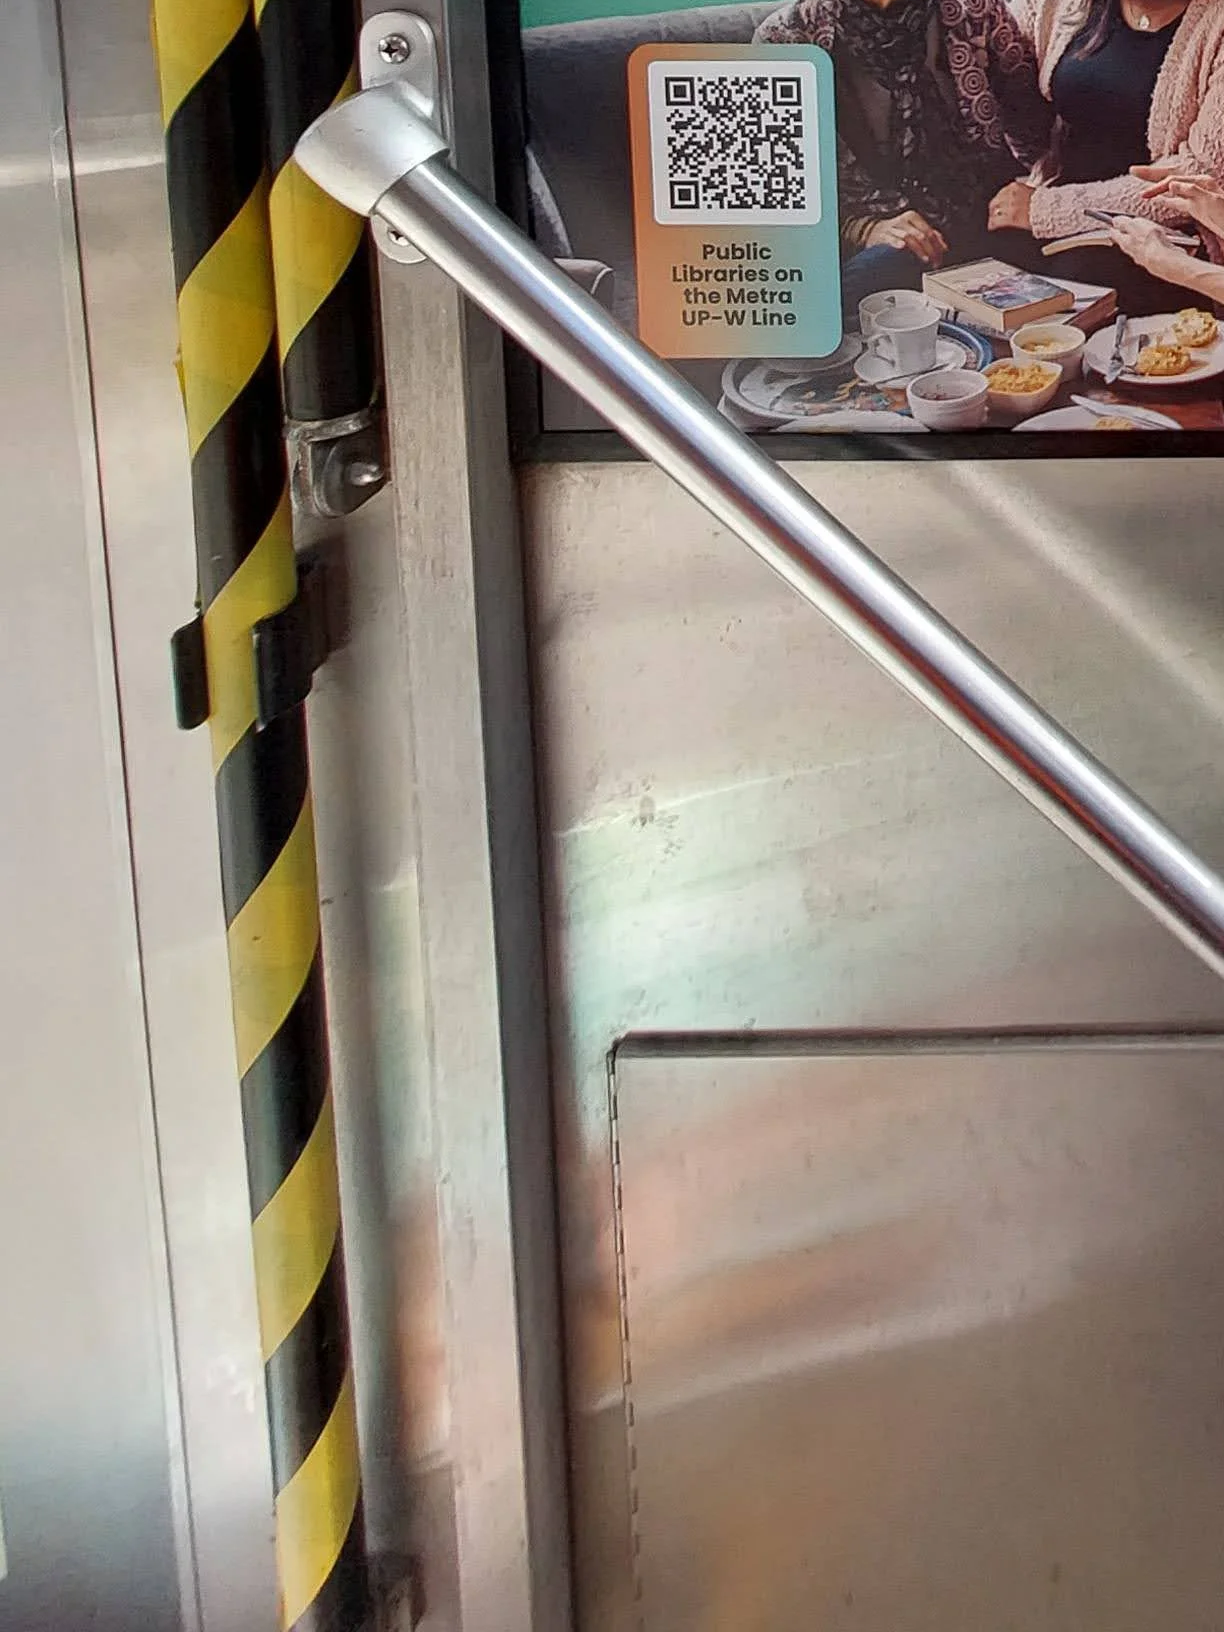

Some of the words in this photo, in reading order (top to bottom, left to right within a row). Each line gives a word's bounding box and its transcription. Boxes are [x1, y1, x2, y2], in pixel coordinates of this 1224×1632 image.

[702, 242, 772, 261] Public
[672, 264, 770, 283] Libraries
[774, 268, 804, 282] on
[684, 287, 721, 304] the
[726, 288, 793, 305] Metra
[682, 310, 746, 326] UP-W
[752, 308, 797, 326] Line
